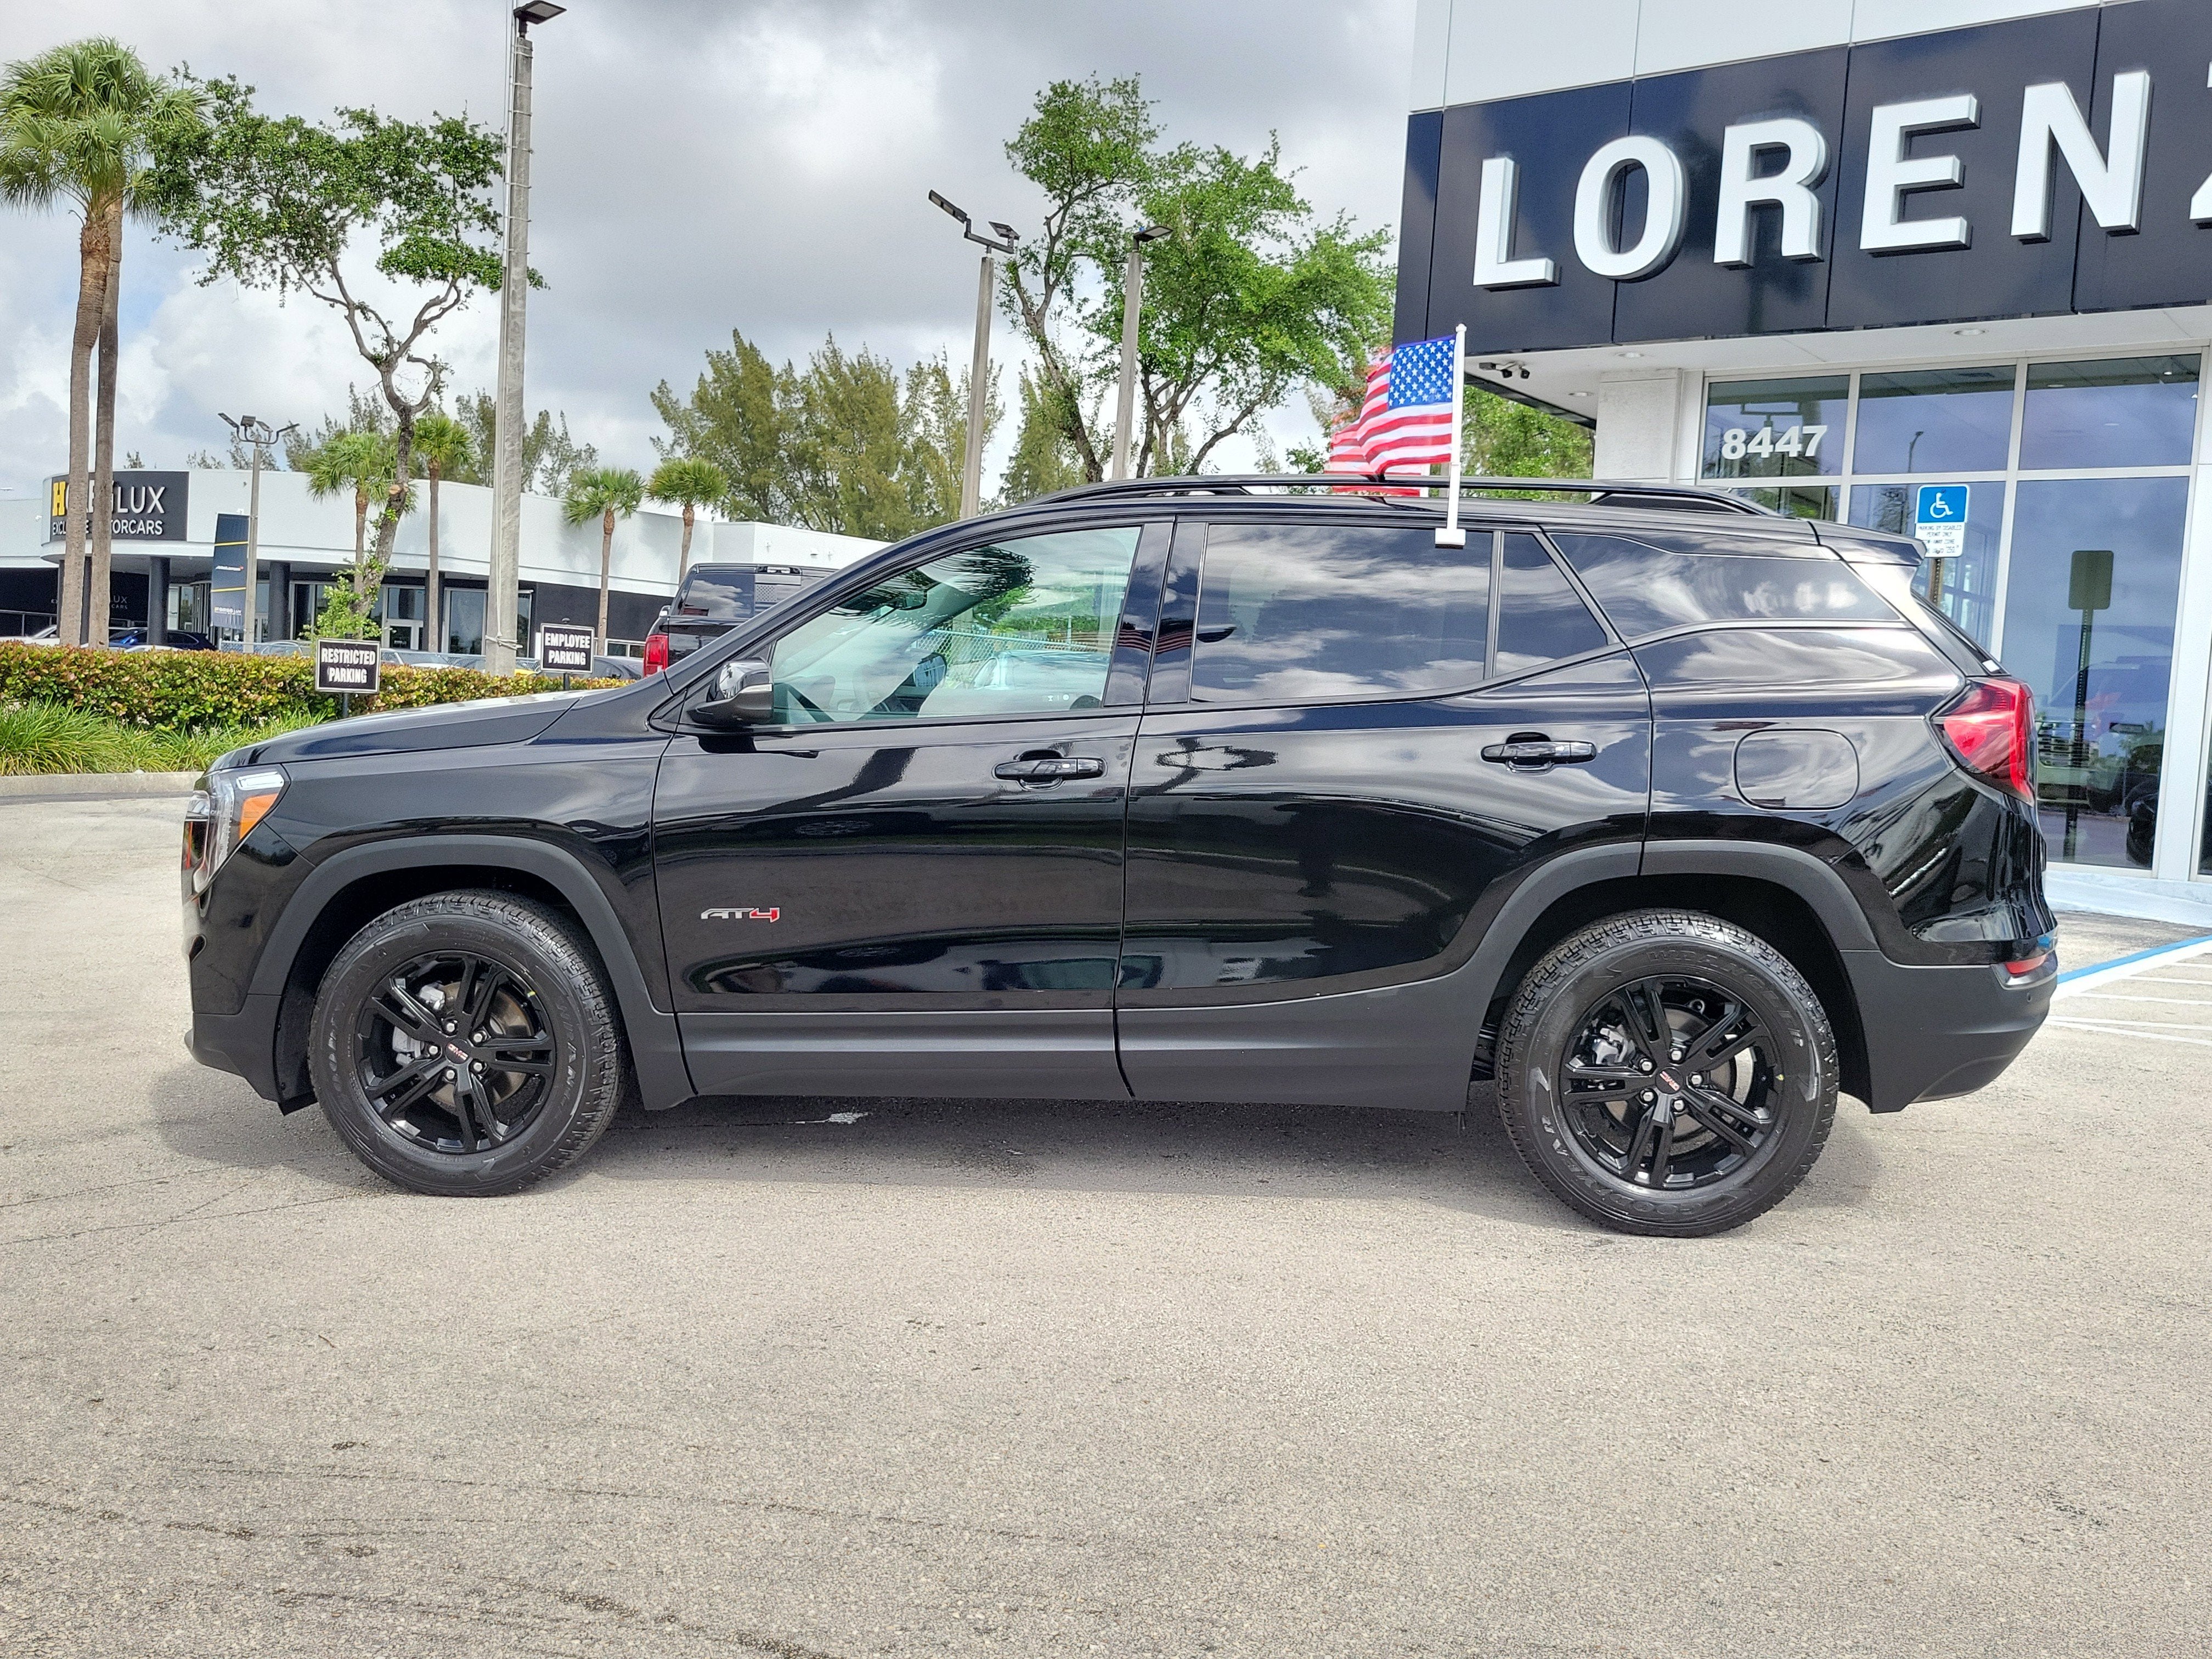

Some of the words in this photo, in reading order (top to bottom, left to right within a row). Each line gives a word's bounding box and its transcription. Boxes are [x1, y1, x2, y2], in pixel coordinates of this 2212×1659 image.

[1473, 60, 2212, 290] LOREN
[1722, 425, 1827, 460] 8447
[53, 520, 89, 535] EXCLE
[111, 520, 163, 535] ORCARS
[545, 633, 591, 649] EMPLOYEE
[321, 647, 376, 665] RESTRICTED
[549, 650, 586, 665] PARKING
[329, 667, 368, 684] PARKING
[701, 907, 780, 923] AT4
